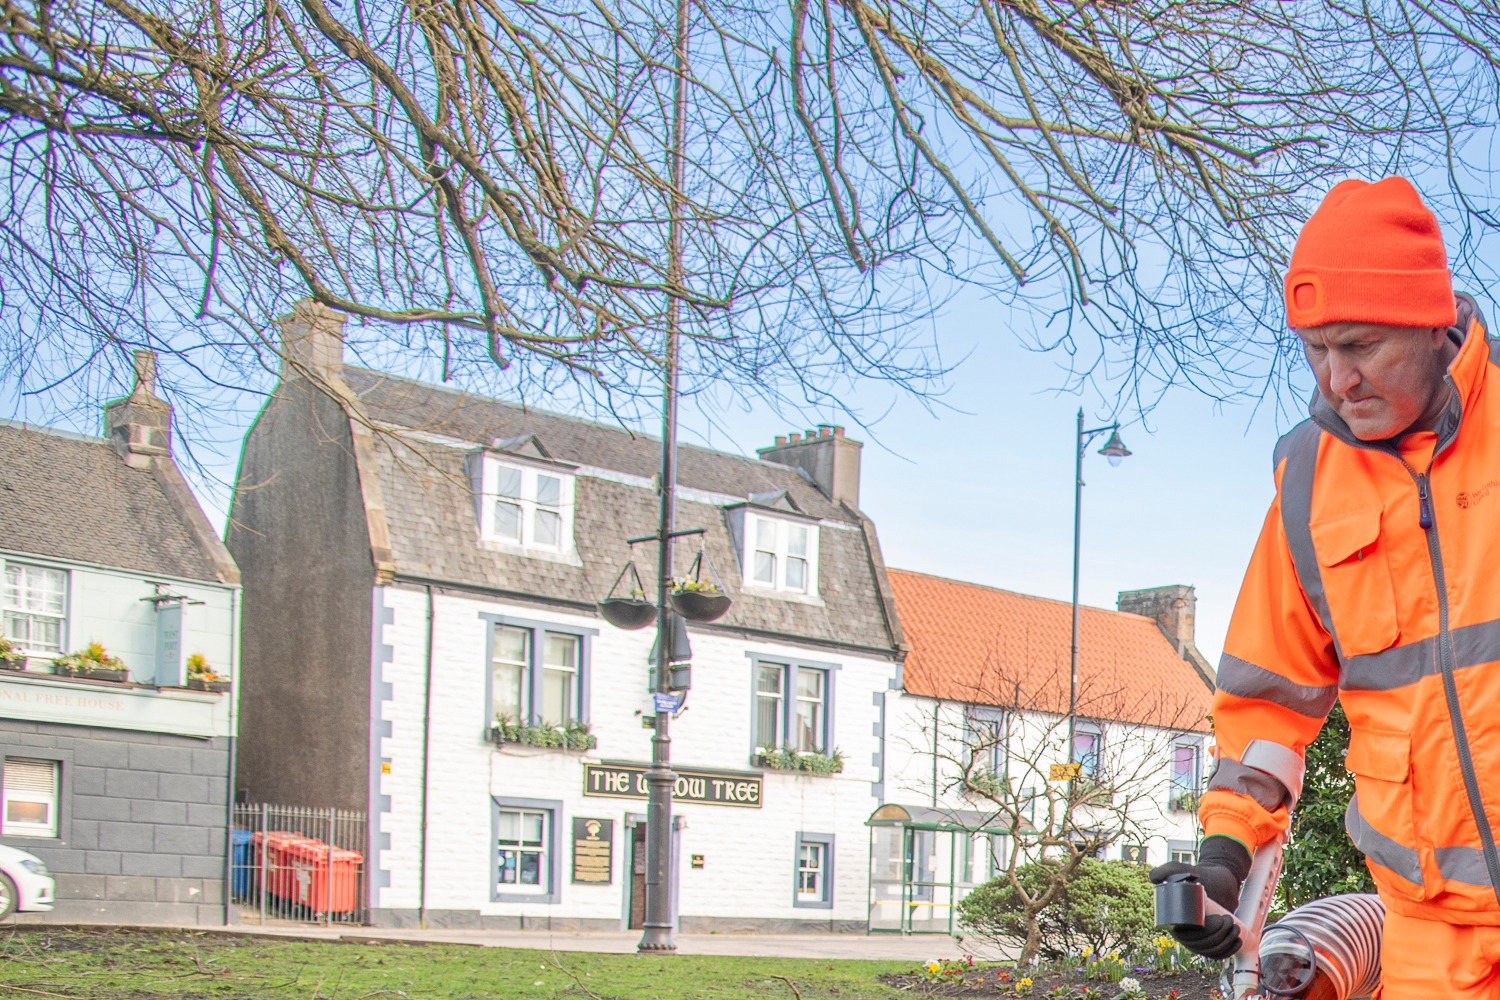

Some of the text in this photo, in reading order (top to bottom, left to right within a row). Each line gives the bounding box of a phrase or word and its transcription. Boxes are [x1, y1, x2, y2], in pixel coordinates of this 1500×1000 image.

[0, 689, 124, 711] NAL FREE HOUSE
[590, 769, 630, 793] THE
[712, 779, 759, 801] TREE
